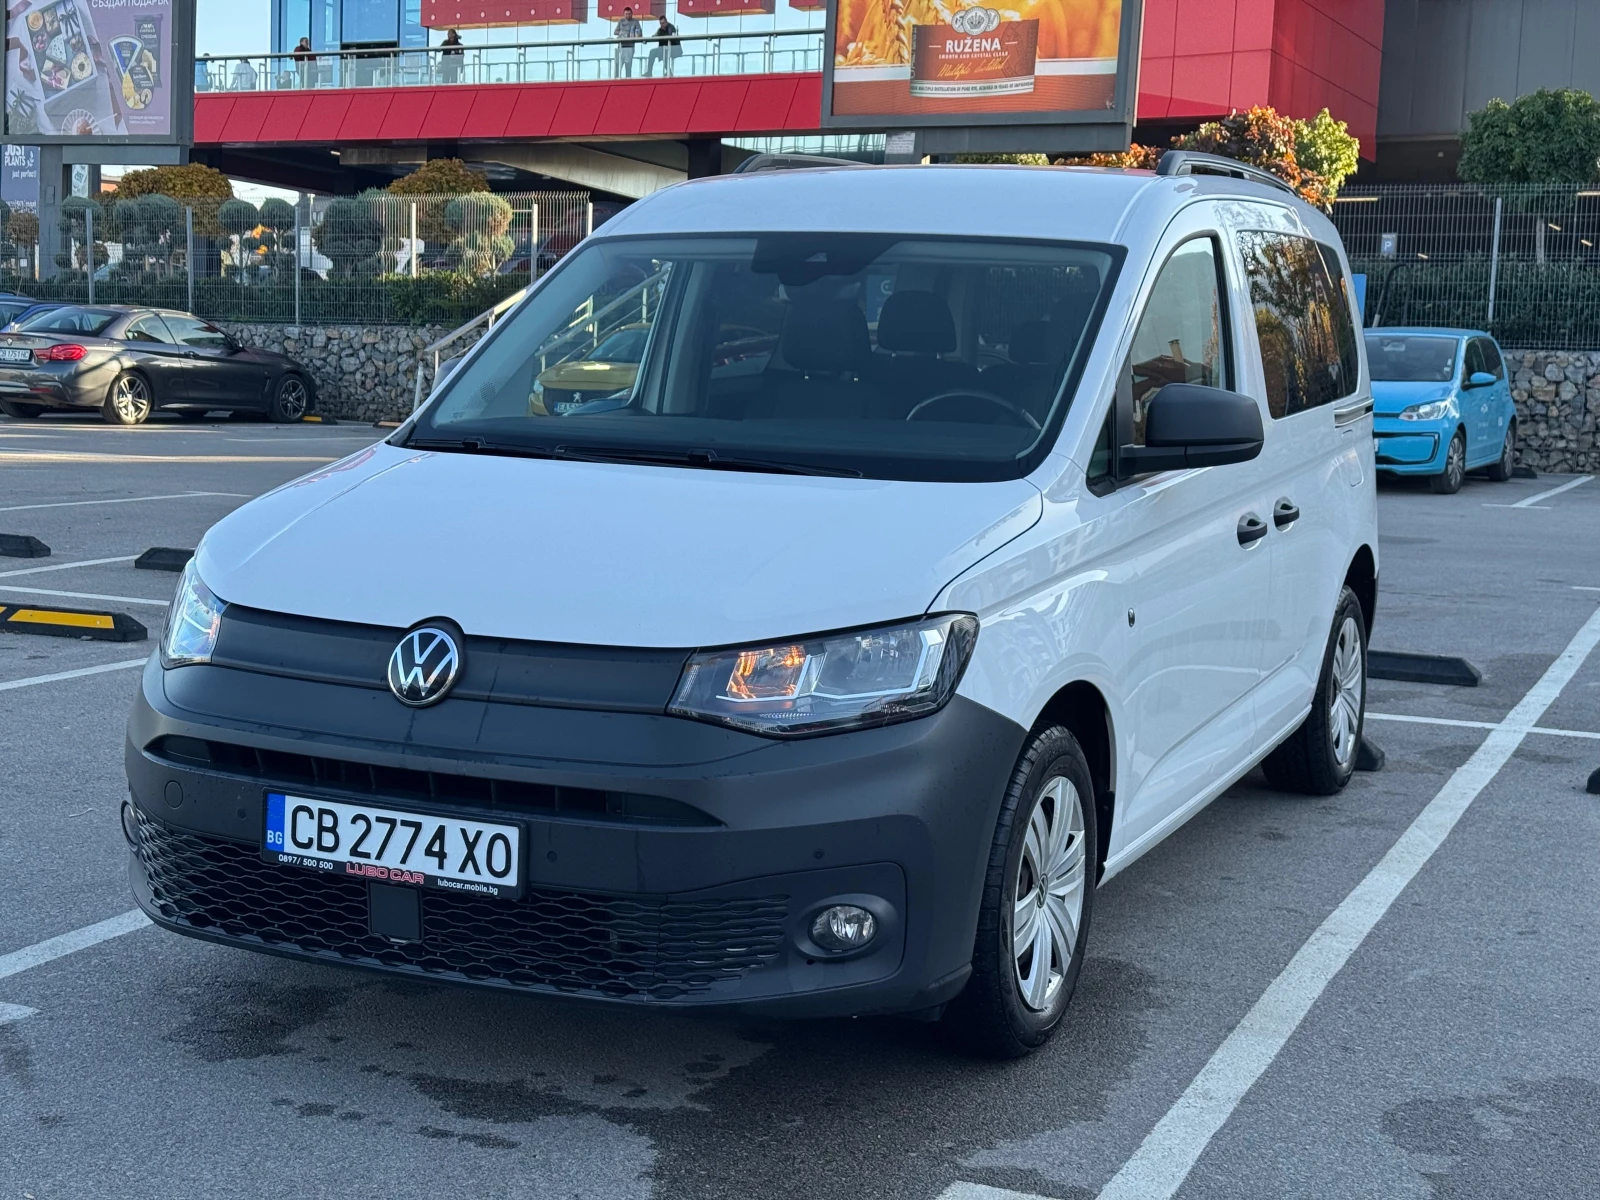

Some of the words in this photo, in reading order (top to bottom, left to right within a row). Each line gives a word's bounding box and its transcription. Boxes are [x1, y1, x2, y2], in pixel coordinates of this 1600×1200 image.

[945, 36, 1001, 53] RUŽENA
[5, 156, 26, 167] PLANTS
[1385, 241, 1391, 251] P
[266, 829, 283, 845] BG
[290, 804, 340, 853] CB
[349, 813, 447, 870] 2774
[458, 827, 512, 878] XO
[278, 854, 302, 864] 0897/
[303, 858, 317, 867] 500
[318, 861, 333, 870] 500
[346, 862, 388, 878] LUBO
[390, 869, 425, 885] CAR
[437, 878, 498, 896] lubocar.mobile.bg
